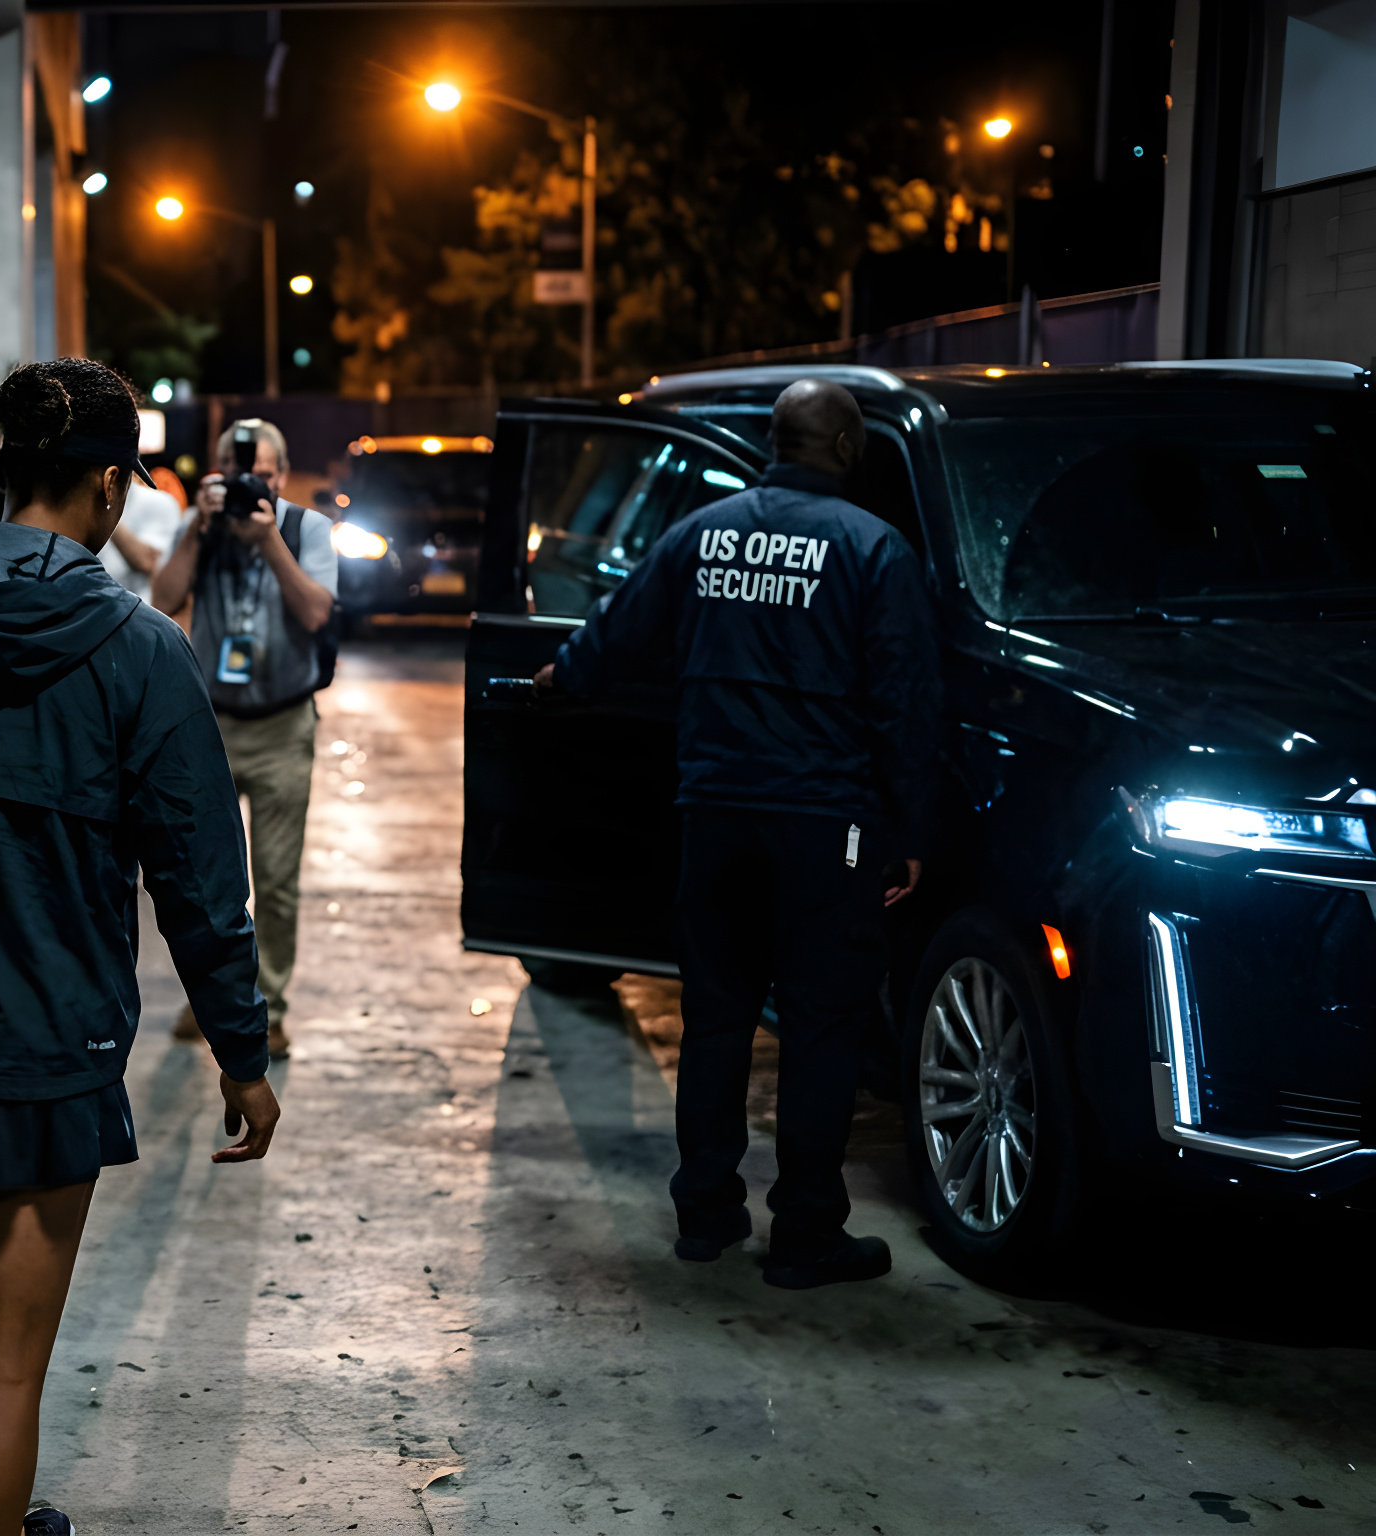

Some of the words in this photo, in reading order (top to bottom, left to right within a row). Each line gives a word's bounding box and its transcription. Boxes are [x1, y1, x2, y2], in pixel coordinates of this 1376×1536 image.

[698, 528, 740, 562] US
[744, 531, 829, 573] OPEN
[695, 566, 821, 609] SECURITY
